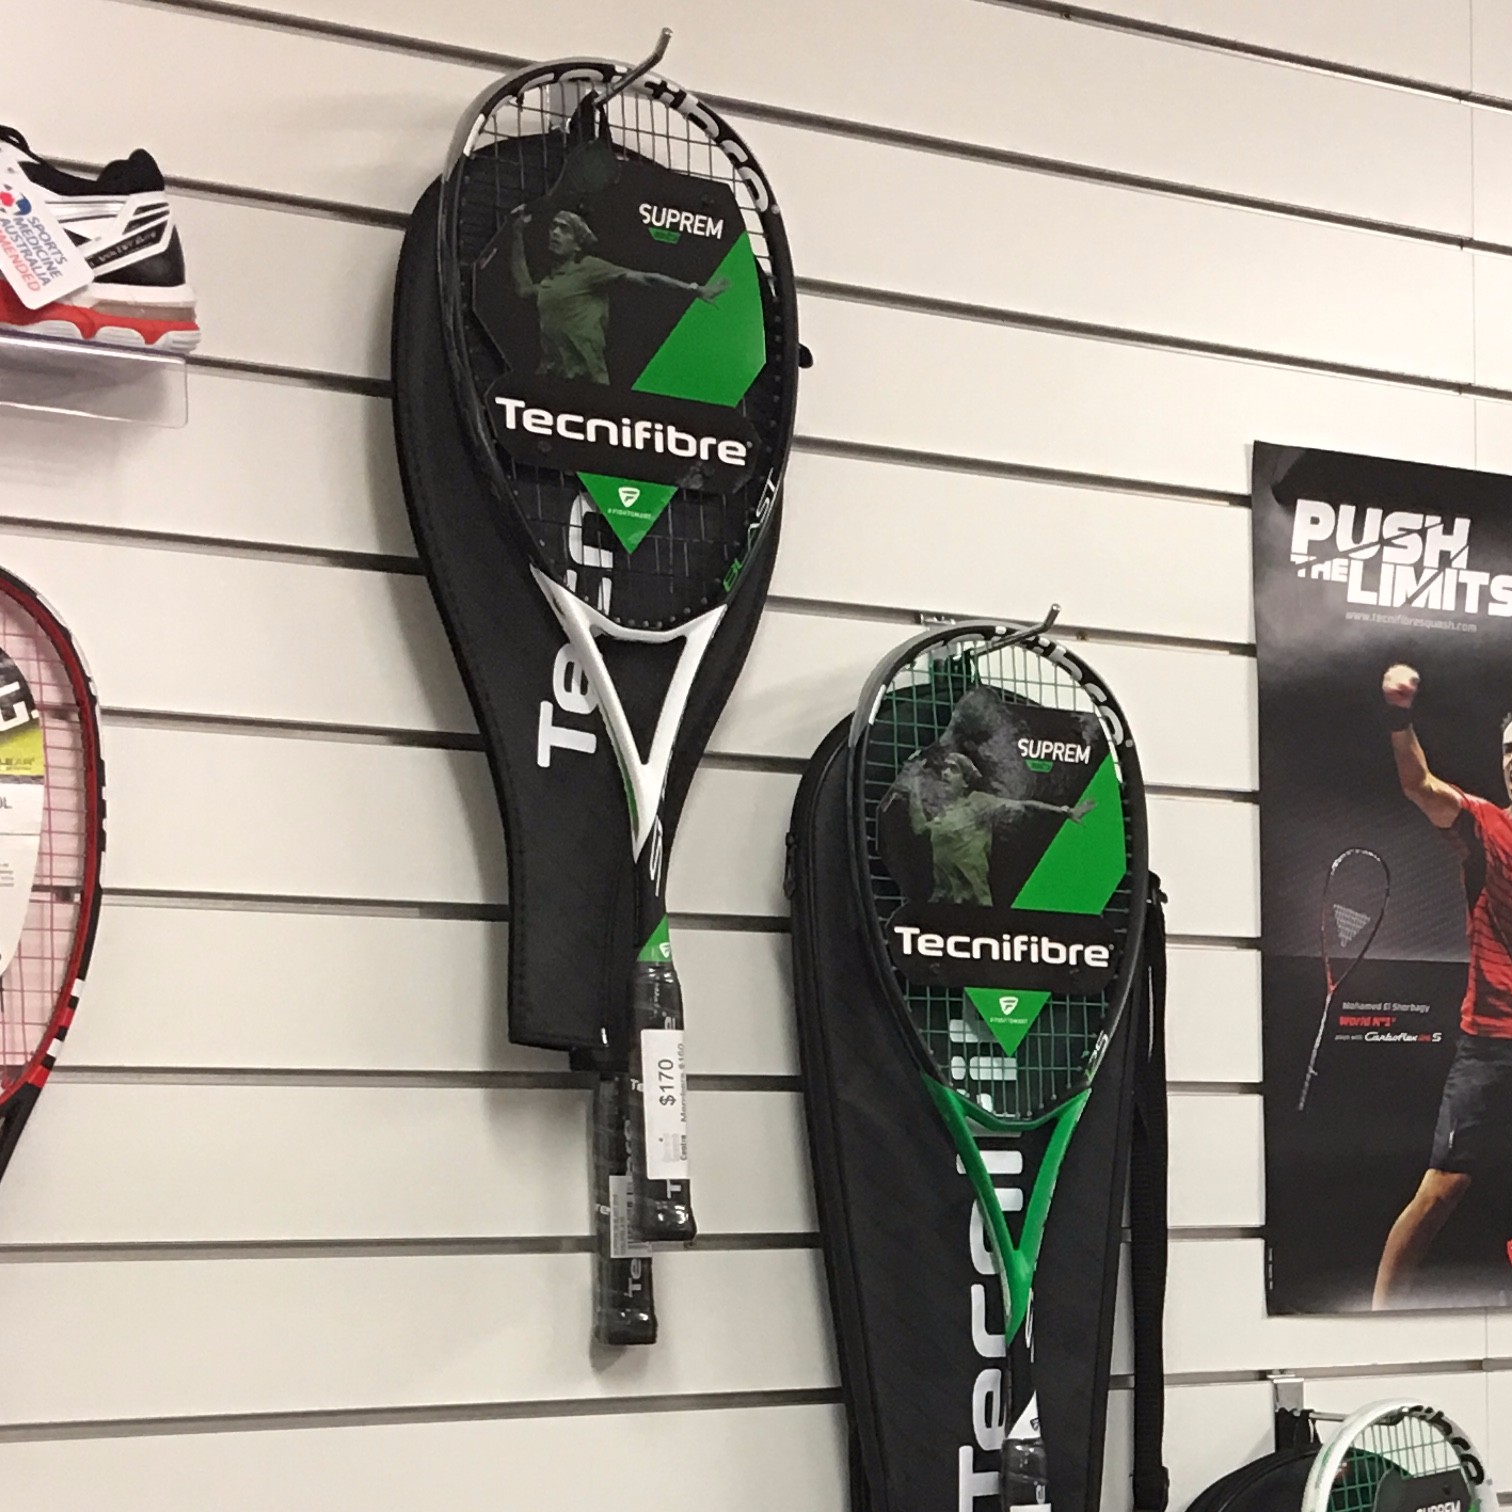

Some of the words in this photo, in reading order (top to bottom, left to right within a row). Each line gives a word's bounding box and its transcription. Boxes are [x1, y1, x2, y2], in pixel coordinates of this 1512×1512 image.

[28, 216, 68, 265] SPORTS
[639, 203, 725, 240] SUPREM
[0, 218, 51, 286] AUSTRALIA
[13, 217, 63, 279] MEDICINE
[495, 397, 748, 466] Tecnifibre
[1290, 499, 1471, 570] PUSH
[1290, 553, 1348, 583] THE
[1017, 738, 1092, 765] SUPREM
[894, 925, 1110, 968] Tecnifibre
[659, 1058, 676, 1107] $170
